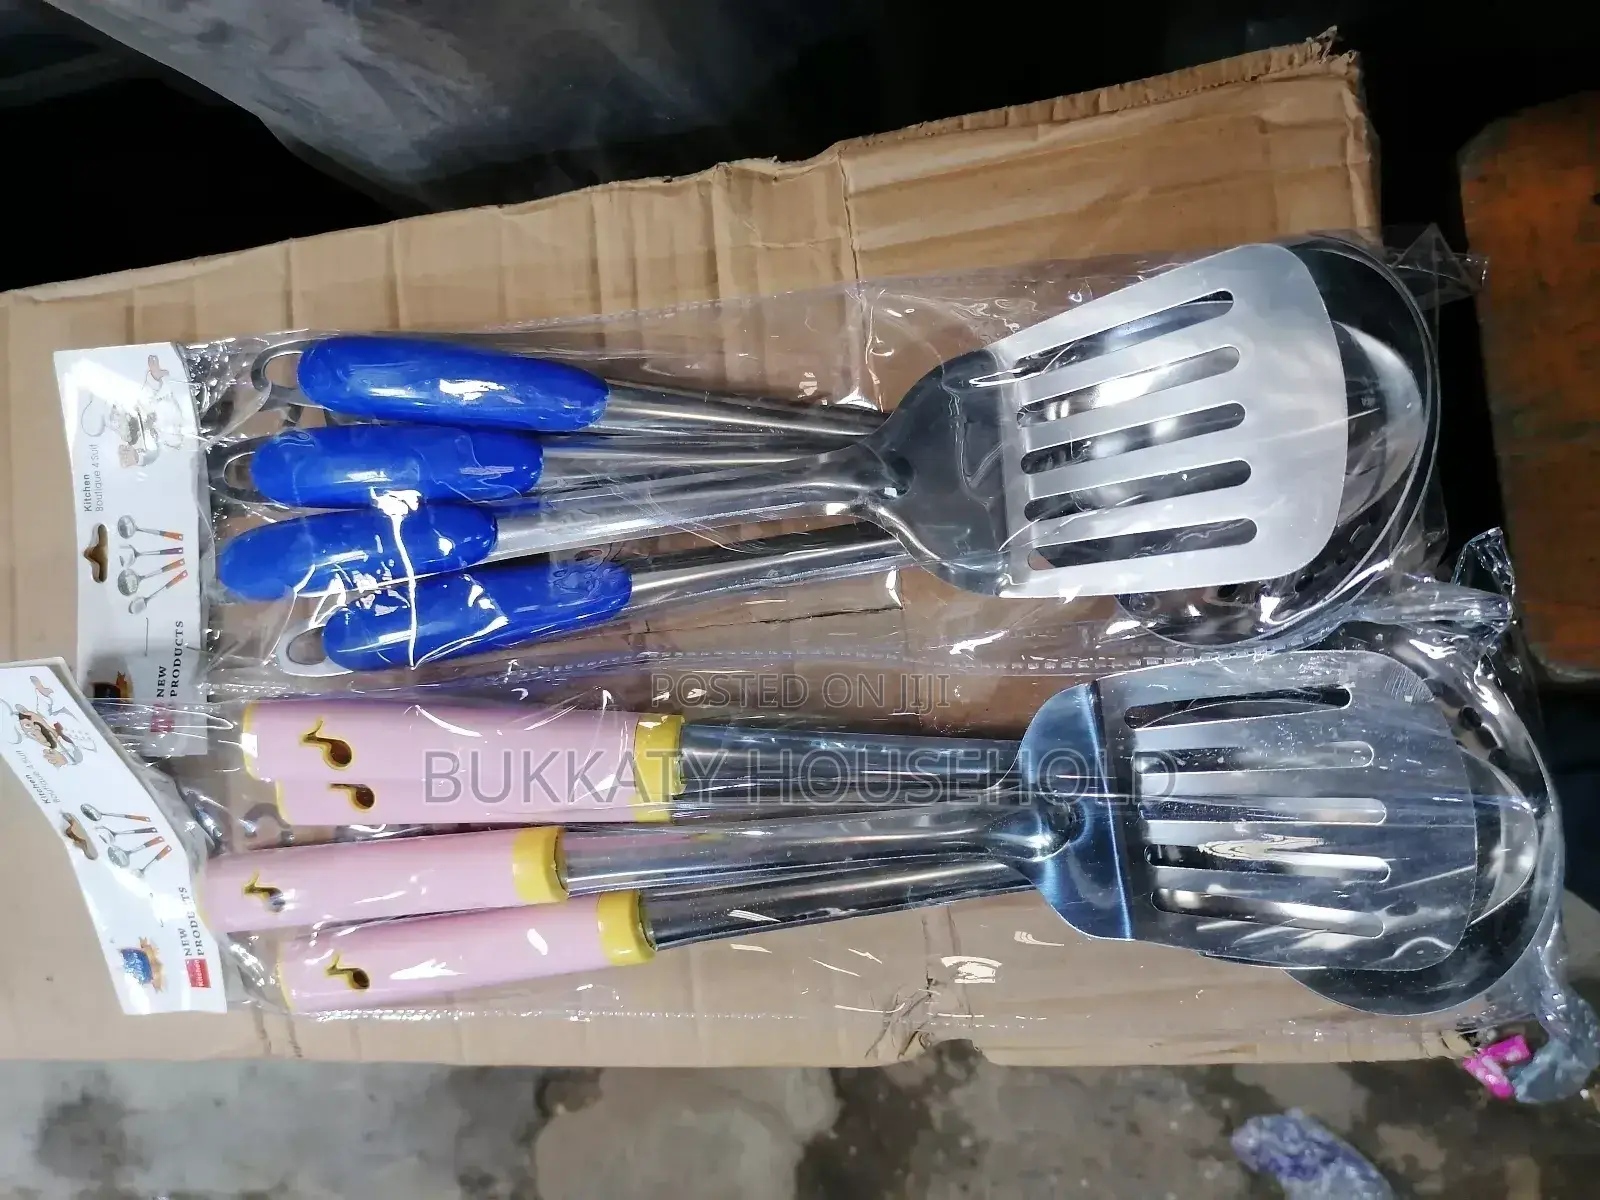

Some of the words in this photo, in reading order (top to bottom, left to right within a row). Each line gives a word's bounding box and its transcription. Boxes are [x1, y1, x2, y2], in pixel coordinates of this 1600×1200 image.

[83, 474, 92, 512] Kitchen
[169, 620, 185, 698] PRODUCTS
[156, 665, 168, 699] NEW
[25, 774, 51, 803] Kitchen
[178, 886, 205, 956] PRODUTS
[178, 927, 192, 957] NEW
